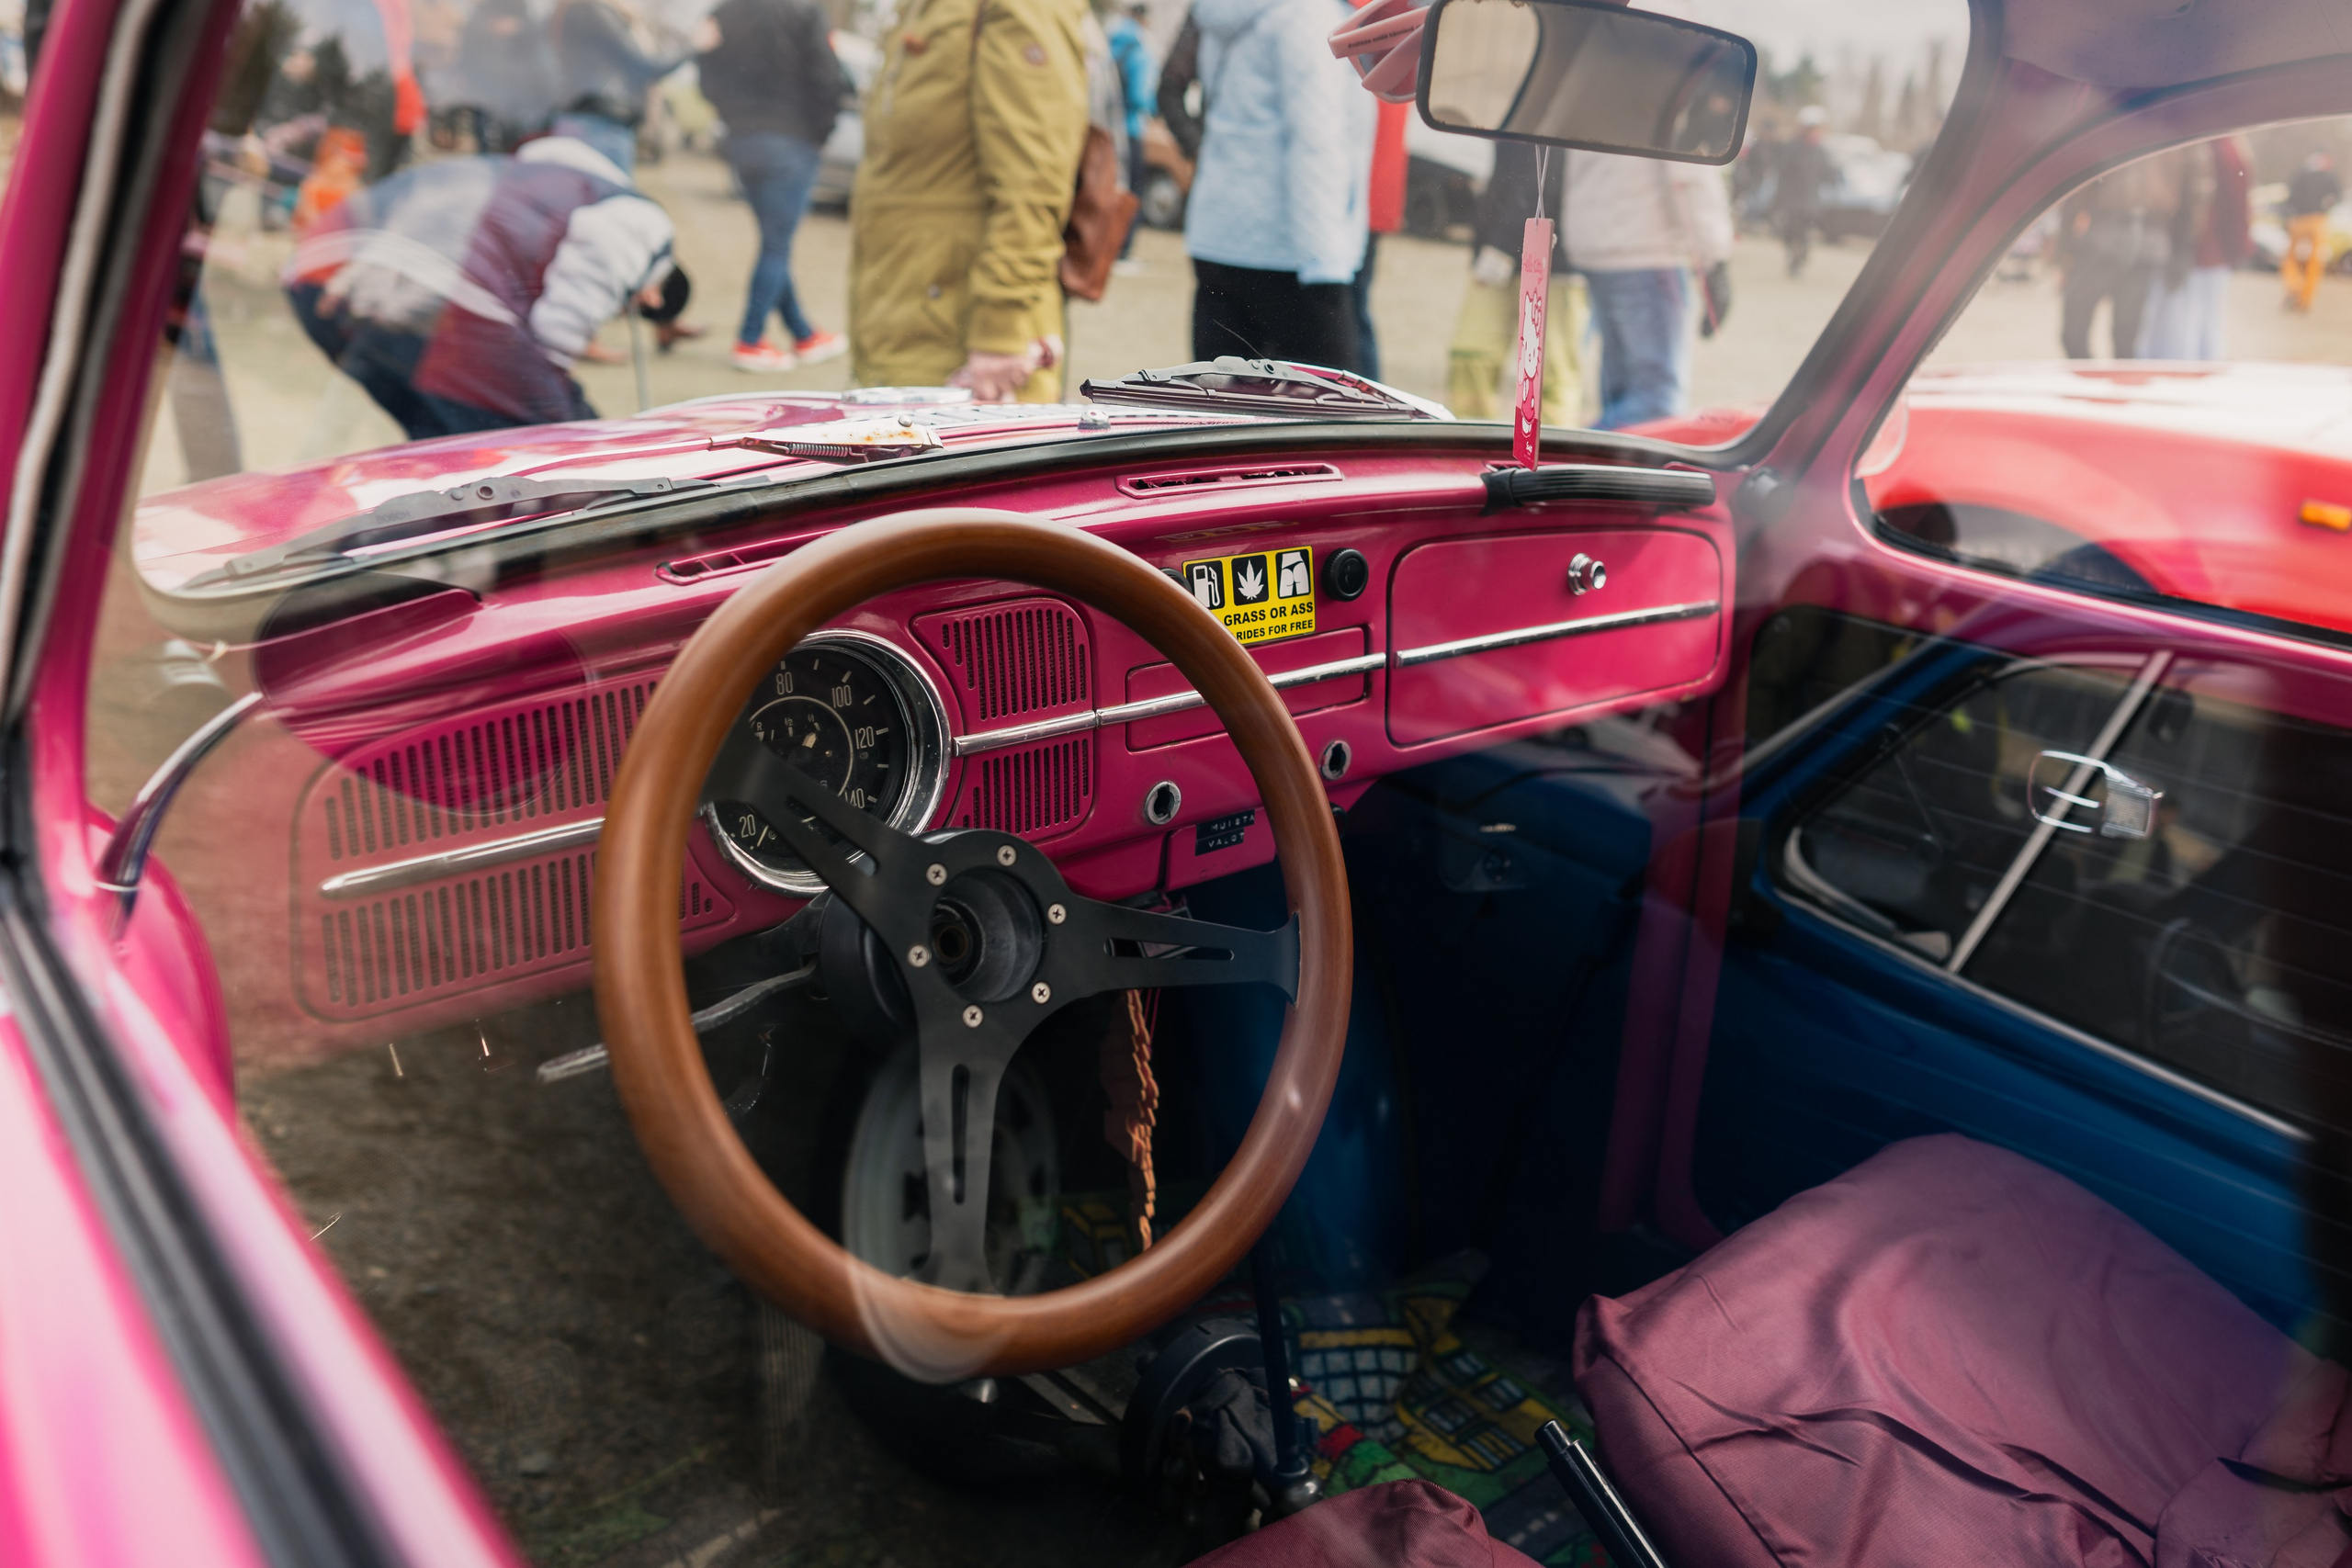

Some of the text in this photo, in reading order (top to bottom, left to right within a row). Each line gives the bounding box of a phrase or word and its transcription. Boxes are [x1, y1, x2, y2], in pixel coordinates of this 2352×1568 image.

[1224, 602, 1314, 626] GRASS OR ASS
[1236, 619, 1313, 640] RIDES FOR FREE
[775, 671, 794, 696] 80
[831, 685, 853, 709] 100
[756, 721, 763, 731] R
[854, 726, 875, 750] 120
[739, 814, 757, 839] 20
[1212, 815, 1254, 830] MUISTA
